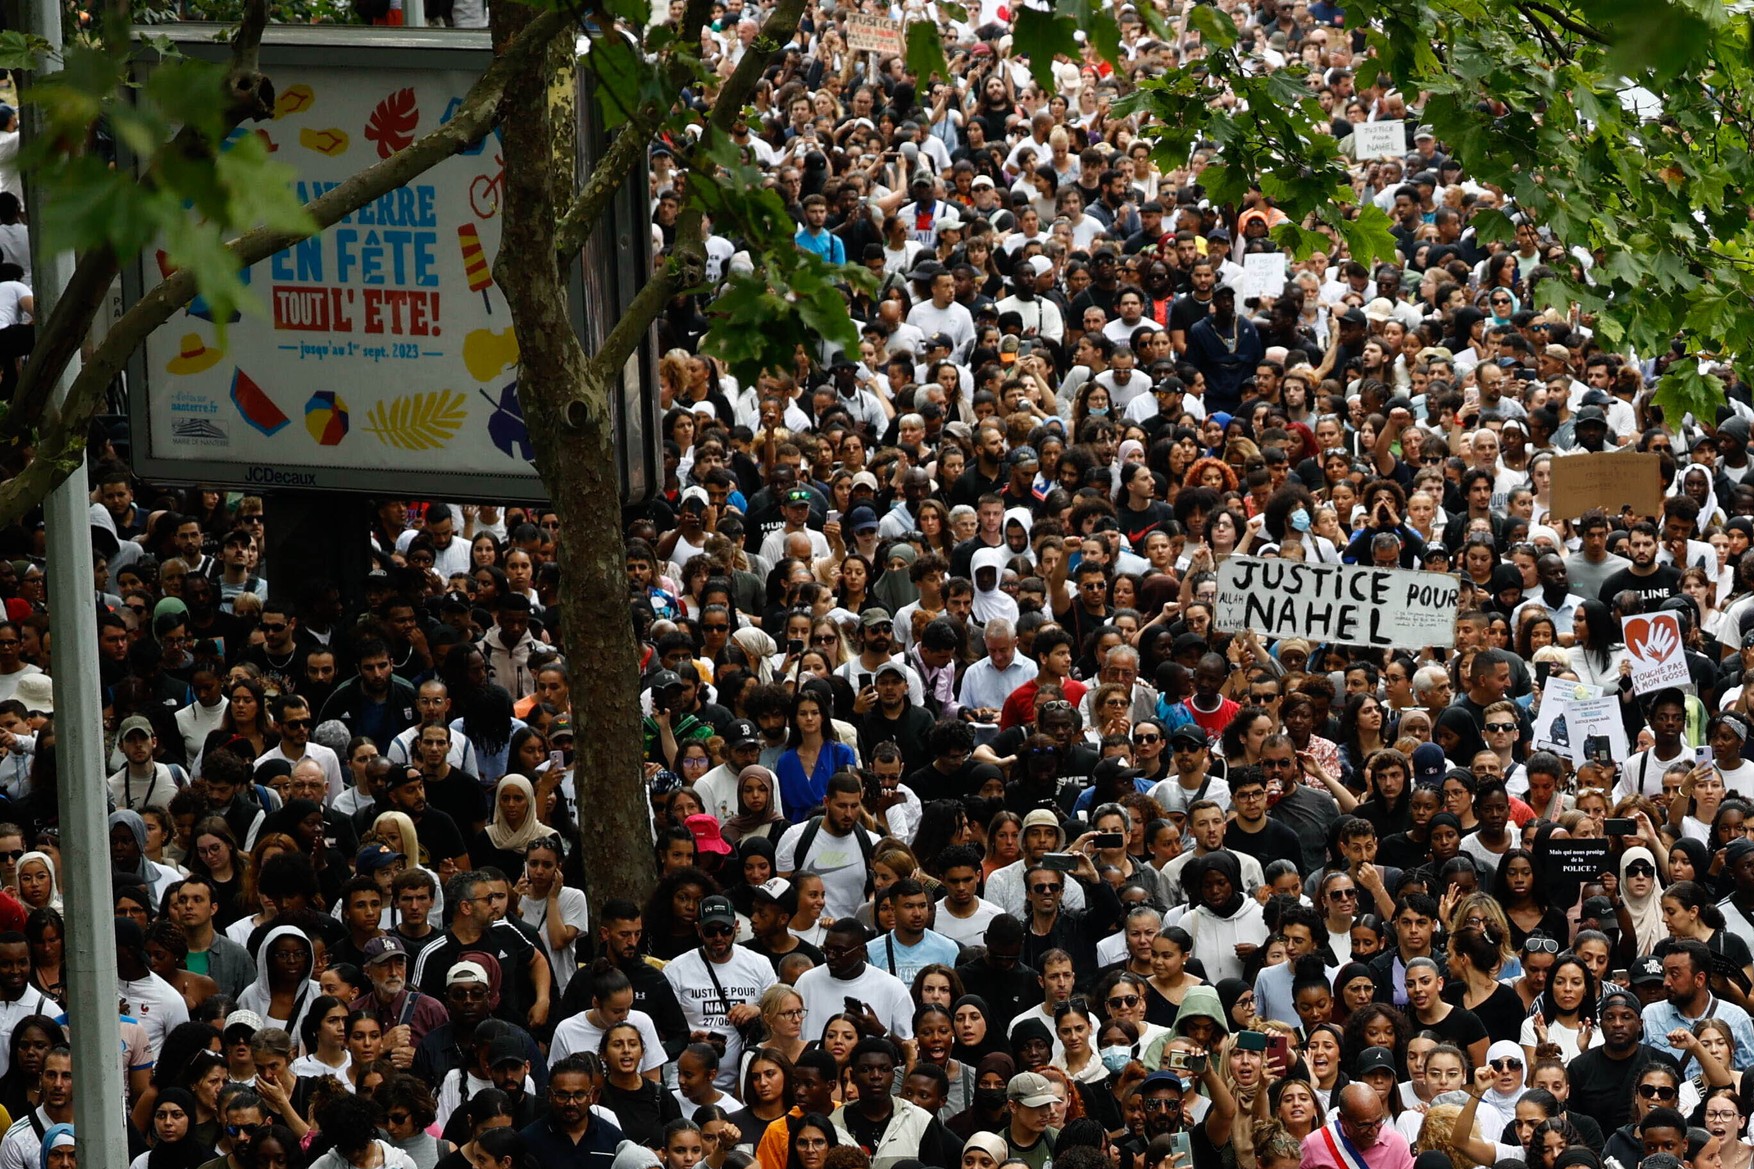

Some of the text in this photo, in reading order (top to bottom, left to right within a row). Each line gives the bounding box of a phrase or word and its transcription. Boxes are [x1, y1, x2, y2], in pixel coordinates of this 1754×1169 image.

[294, 181, 437, 227] AERRE
[271, 228, 439, 287] EN FÊTE
[277, 291, 325, 326] TOUT
[299, 340, 345, 360] jusqu'au
[363, 344, 389, 362] sept.
[392, 343, 418, 358] 2023
[171, 401, 218, 413] nanterre.fr
[245, 467, 316, 485] JCDecaux
[1407, 583, 1460, 609] POUR
[1243, 592, 1392, 645] NAHEL
[1633, 662, 1684, 684] TOUCHE PAS
[1642, 677, 1660, 691] MON
[1662, 668, 1688, 682] GOSSE
[1563, 849, 1571, 857] qui
[1562, 865, 1591, 873] POLICE
[691, 986, 756, 999] JUSTIE POUR
[703, 1017, 730, 1026] 27/06
